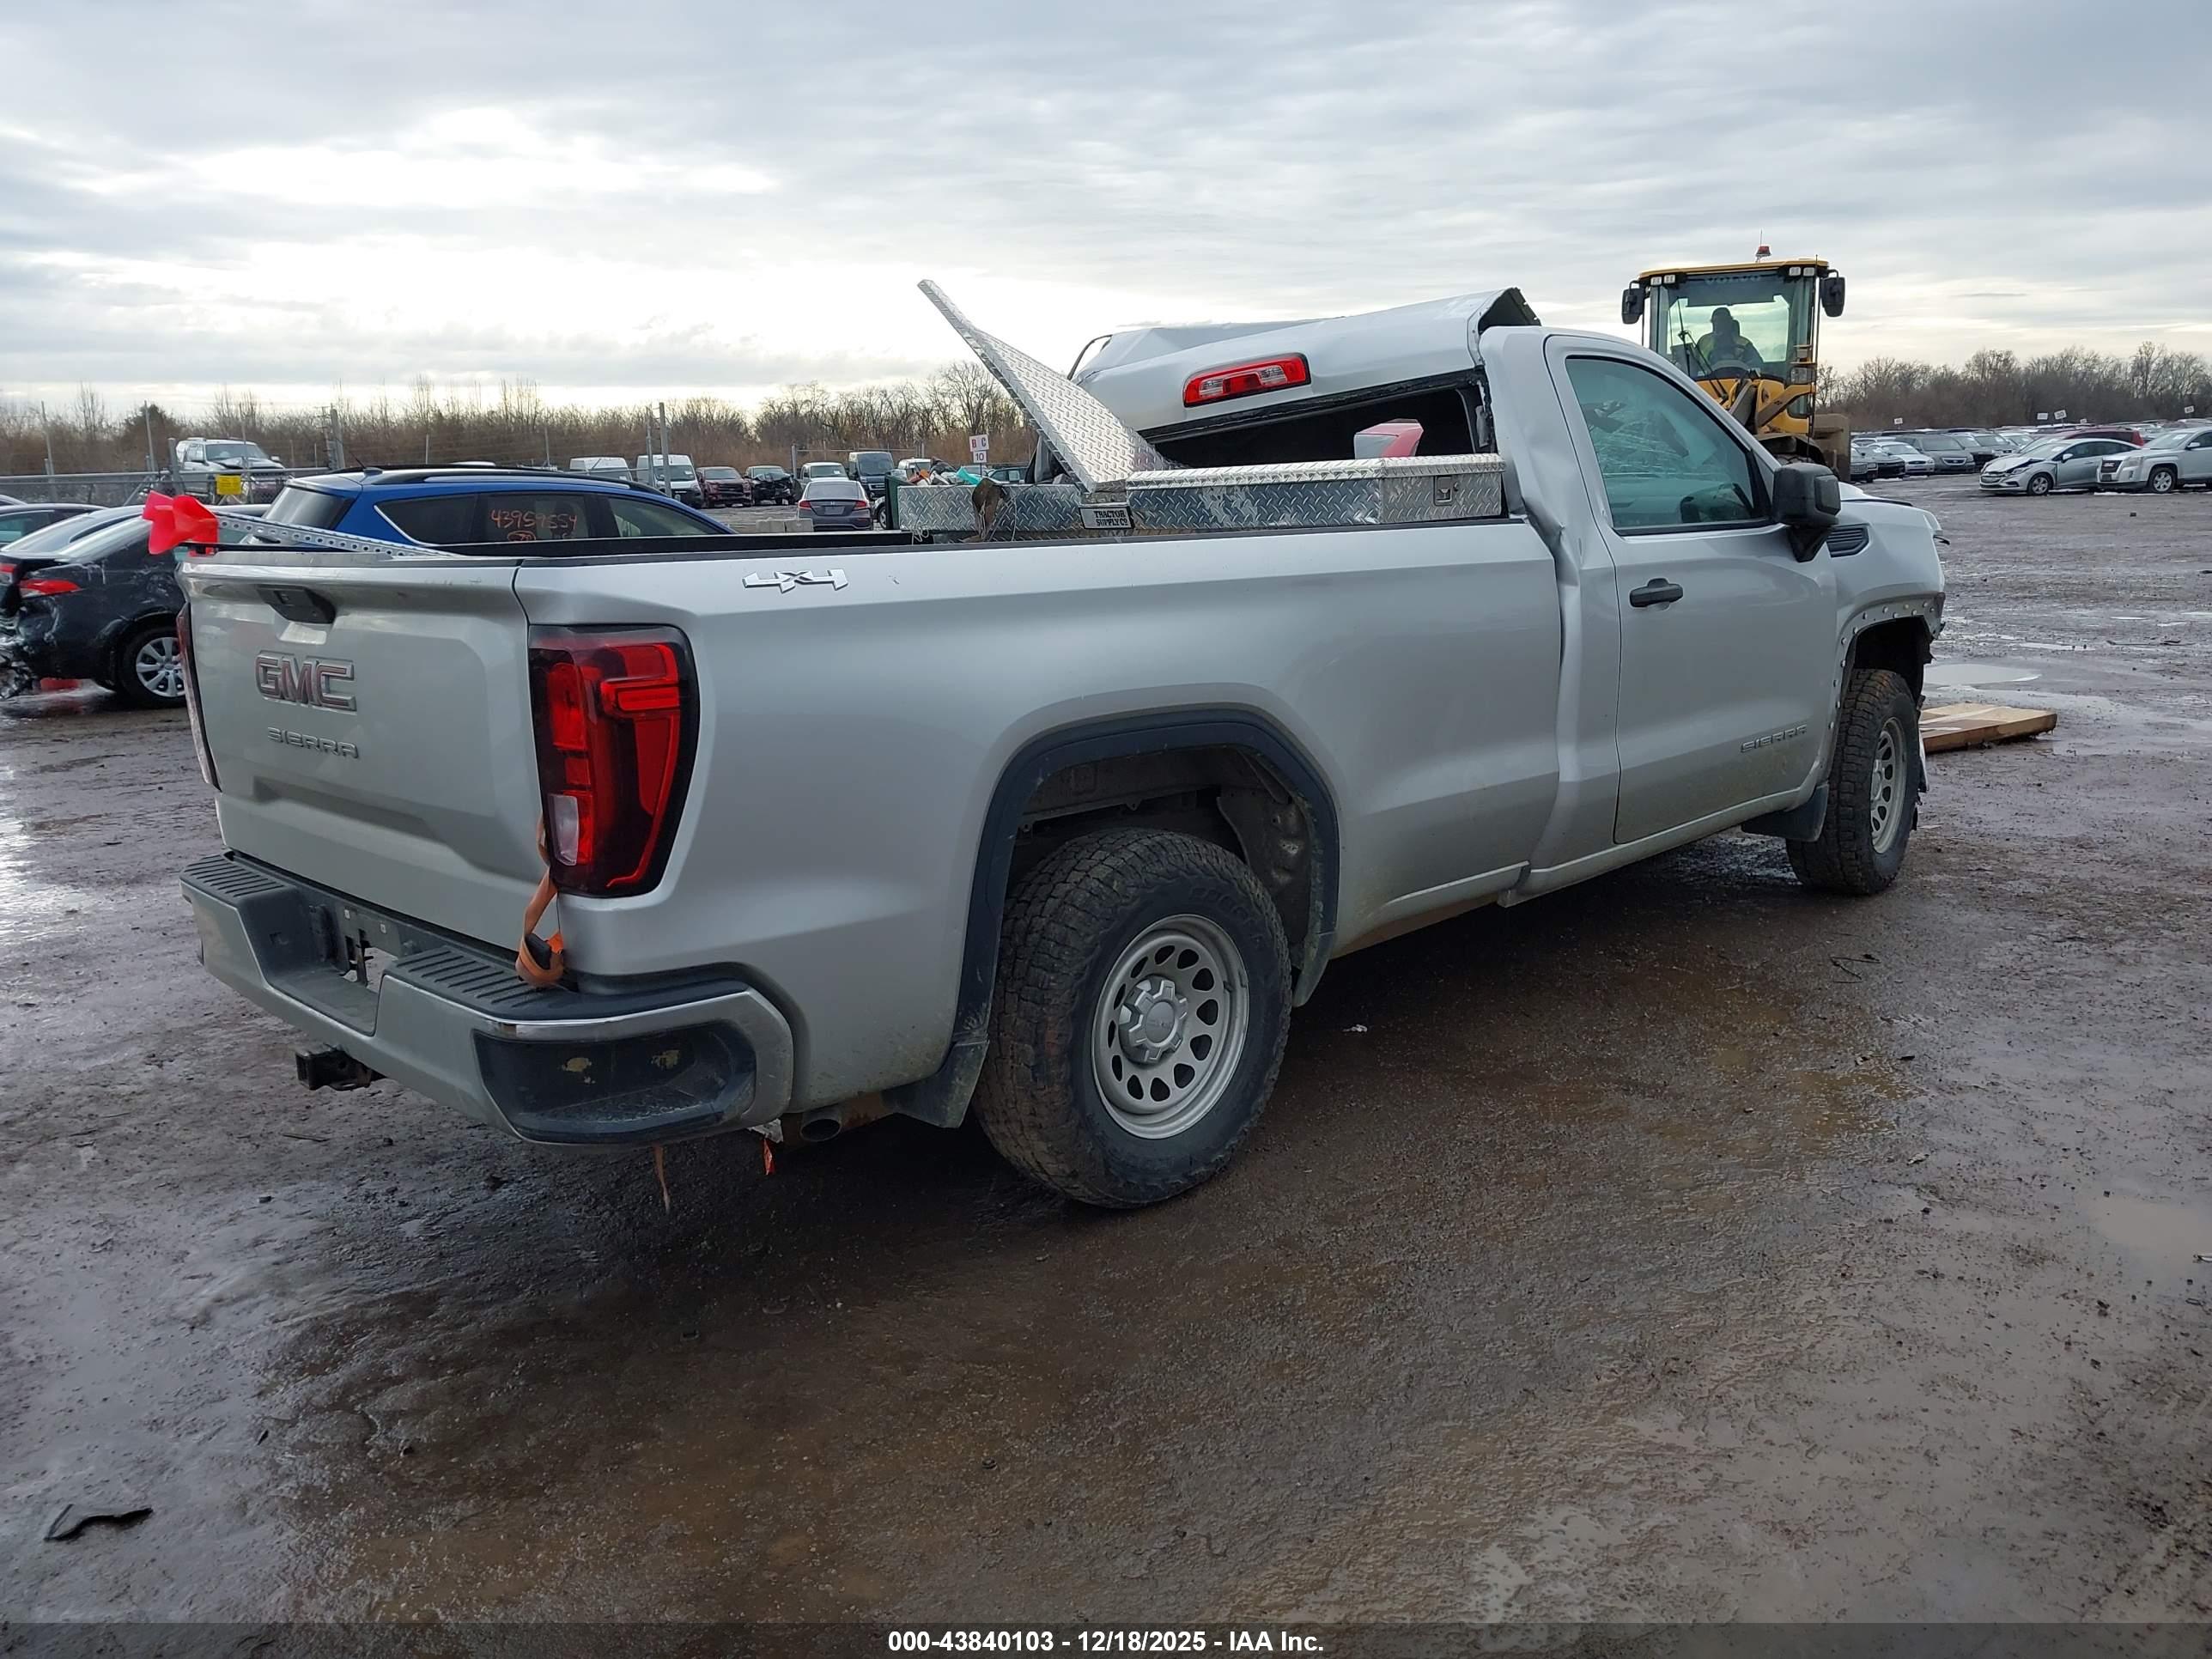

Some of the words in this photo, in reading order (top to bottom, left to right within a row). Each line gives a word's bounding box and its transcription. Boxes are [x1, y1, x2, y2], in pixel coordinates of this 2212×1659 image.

[971, 439, 977, 448] B
[981, 437, 987, 447] C
[975, 453, 985, 461] 10
[1096, 518, 1120, 526] SUPPLY
[256, 650, 357, 715] GMC
[267, 726, 359, 758] SIERRA
[1740, 724, 1808, 753] SIERRA
